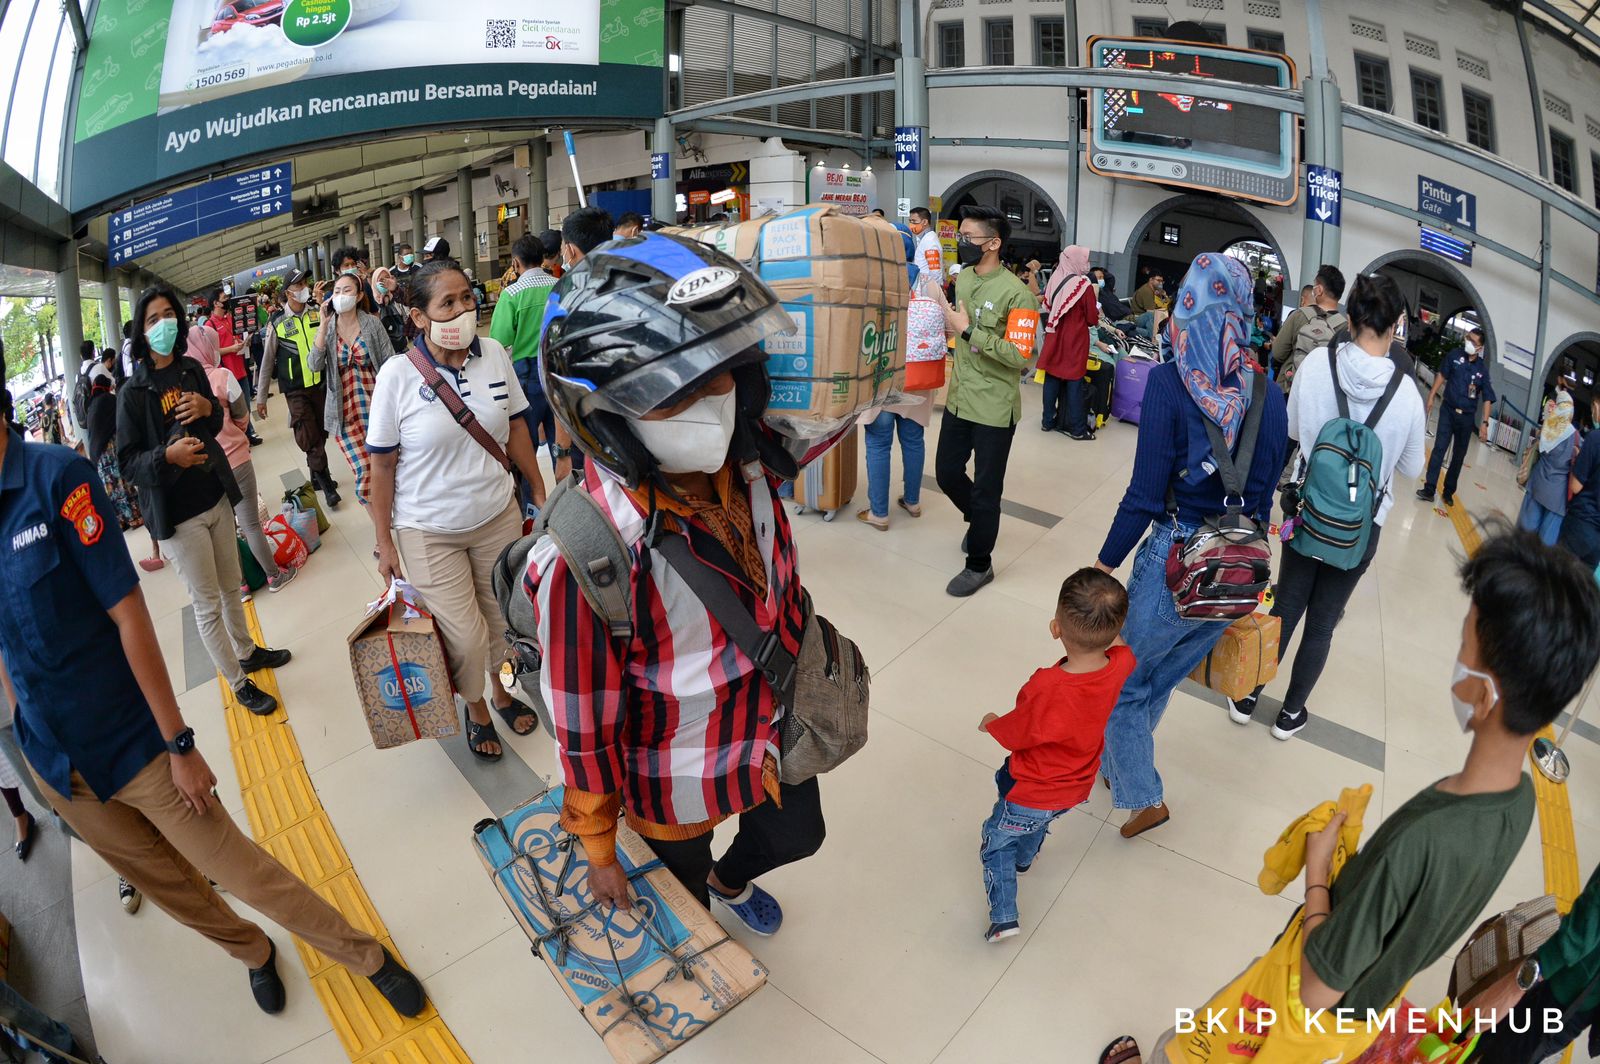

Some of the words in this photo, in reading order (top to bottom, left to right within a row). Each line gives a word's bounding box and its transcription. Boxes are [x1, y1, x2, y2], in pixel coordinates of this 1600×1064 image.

[305, 5, 331, 13] hingga
[296, 17, 310, 27] Rp
[313, 13, 337, 25] 2.5jt
[522, 24, 539, 32] Cicil
[541, 25, 580, 34] Kendaraan
[256, 53, 333, 73] www.pegadaian.co.id
[195, 73, 223, 89] 1500
[224, 67, 246, 82] 569
[165, 128, 201, 153] Ayo
[206, 104, 303, 139] Wujudkan
[308, 88, 420, 116] Rencanamu
[425, 83, 504, 101] Bersama
[508, 79, 598, 100] Pegadaian!
[895, 143, 917, 152] Tiket
[826, 172, 844, 183] BEJO
[1307, 171, 1341, 191] Cetak
[853, 193, 867, 203] BEJO
[1308, 184, 1339, 203] Tiket
[1422, 181, 1452, 203] Pintu
[1455, 193, 1471, 227] 1
[1422, 199, 1442, 214] Gate
[770, 222, 799, 232] REFILL
[772, 235, 797, 244] PACK
[767, 248, 773, 257] 2
[777, 245, 802, 256] LITER
[1017, 318, 1035, 328] KAI
[777, 342, 804, 350] LITER
[64, 487, 87, 514] POLDA
[12, 523, 48, 551] HUMAS
[571, 971, 610, 990] 600ml
